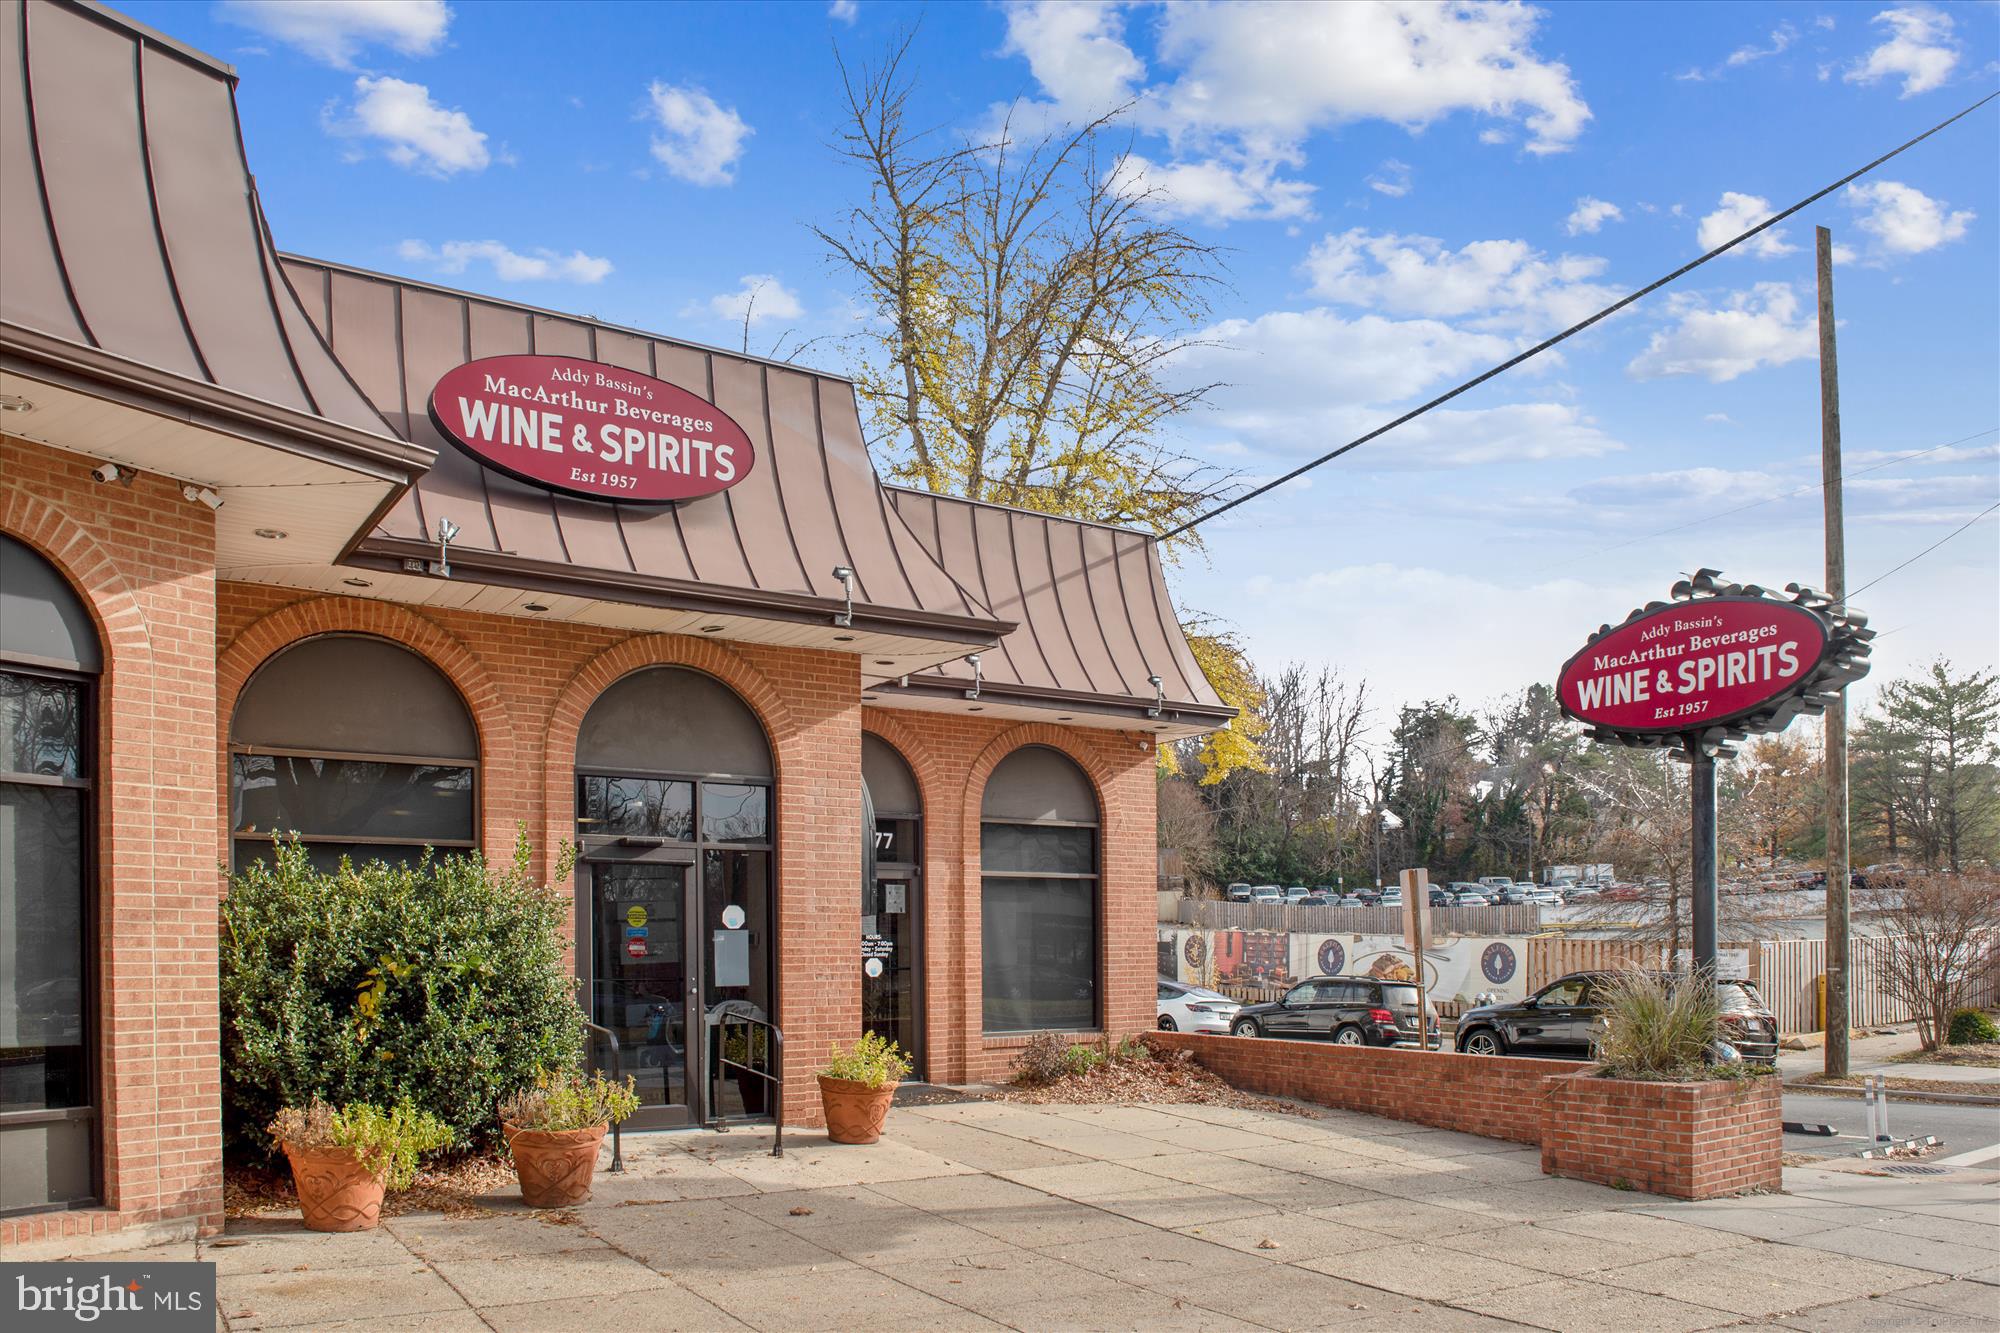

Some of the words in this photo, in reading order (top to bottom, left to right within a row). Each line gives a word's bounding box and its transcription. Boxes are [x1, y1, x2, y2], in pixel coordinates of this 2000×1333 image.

[484, 374, 608, 415] MacArthur
[614, 398, 713, 433] Beverages
[551, 367, 590, 387] Addy
[595, 372, 653, 401] Bassin's
[458, 396, 564, 453] WINE
[572, 424, 595, 454] &
[599, 423, 736, 482] SPIRITS
[570, 467, 597, 483] Est
[601, 472, 638, 490] 1957
[1593, 643, 1684, 672] MacArthur
[1689, 624, 1778, 652] Beverages
[1640, 625, 1670, 642] Addy
[1674, 615, 1723, 632] Bassin's
[1577, 668, 1650, 711] WINE
[1656, 669, 1673, 693] &
[1677, 641, 1799, 694] SPIRITS
[1653, 705, 1675, 720] Est
[1678, 700, 1709, 717] 1957
